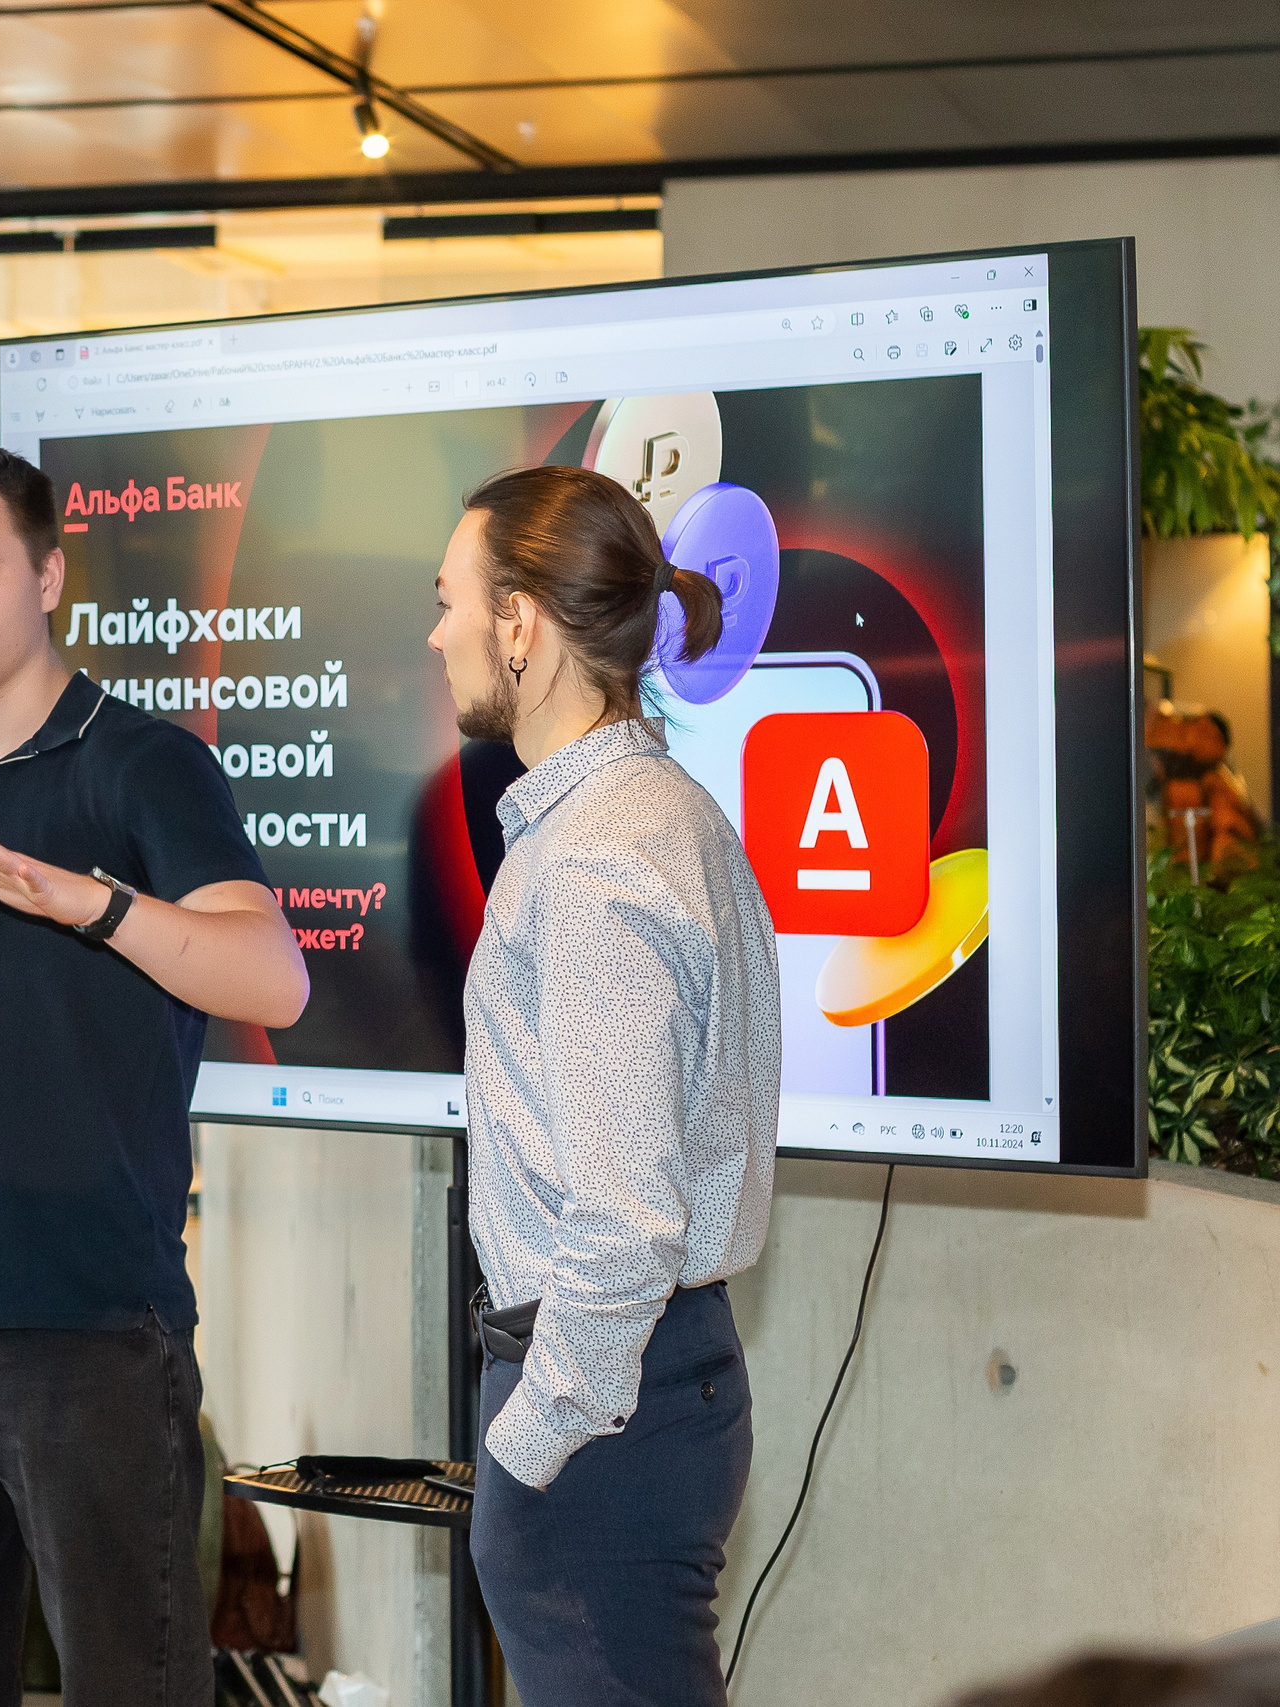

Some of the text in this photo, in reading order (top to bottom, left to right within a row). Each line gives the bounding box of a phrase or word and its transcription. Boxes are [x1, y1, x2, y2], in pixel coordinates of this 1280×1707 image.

[497, 377, 507, 387] 42
[64, 476, 242, 522] Альфа Банк
[65, 598, 301, 654] Лайфхаки
[79, 660, 347, 711] инансовой
[208, 730, 333, 778] овой
[289, 882, 387, 916] мечту?
[291, 923, 364, 950] жет?
[318, 1094, 344, 1105] Поиск
[880, 1123, 1024, 1136] РУС 12:20
[976, 1137, 1024, 1149] 10.11.2024
